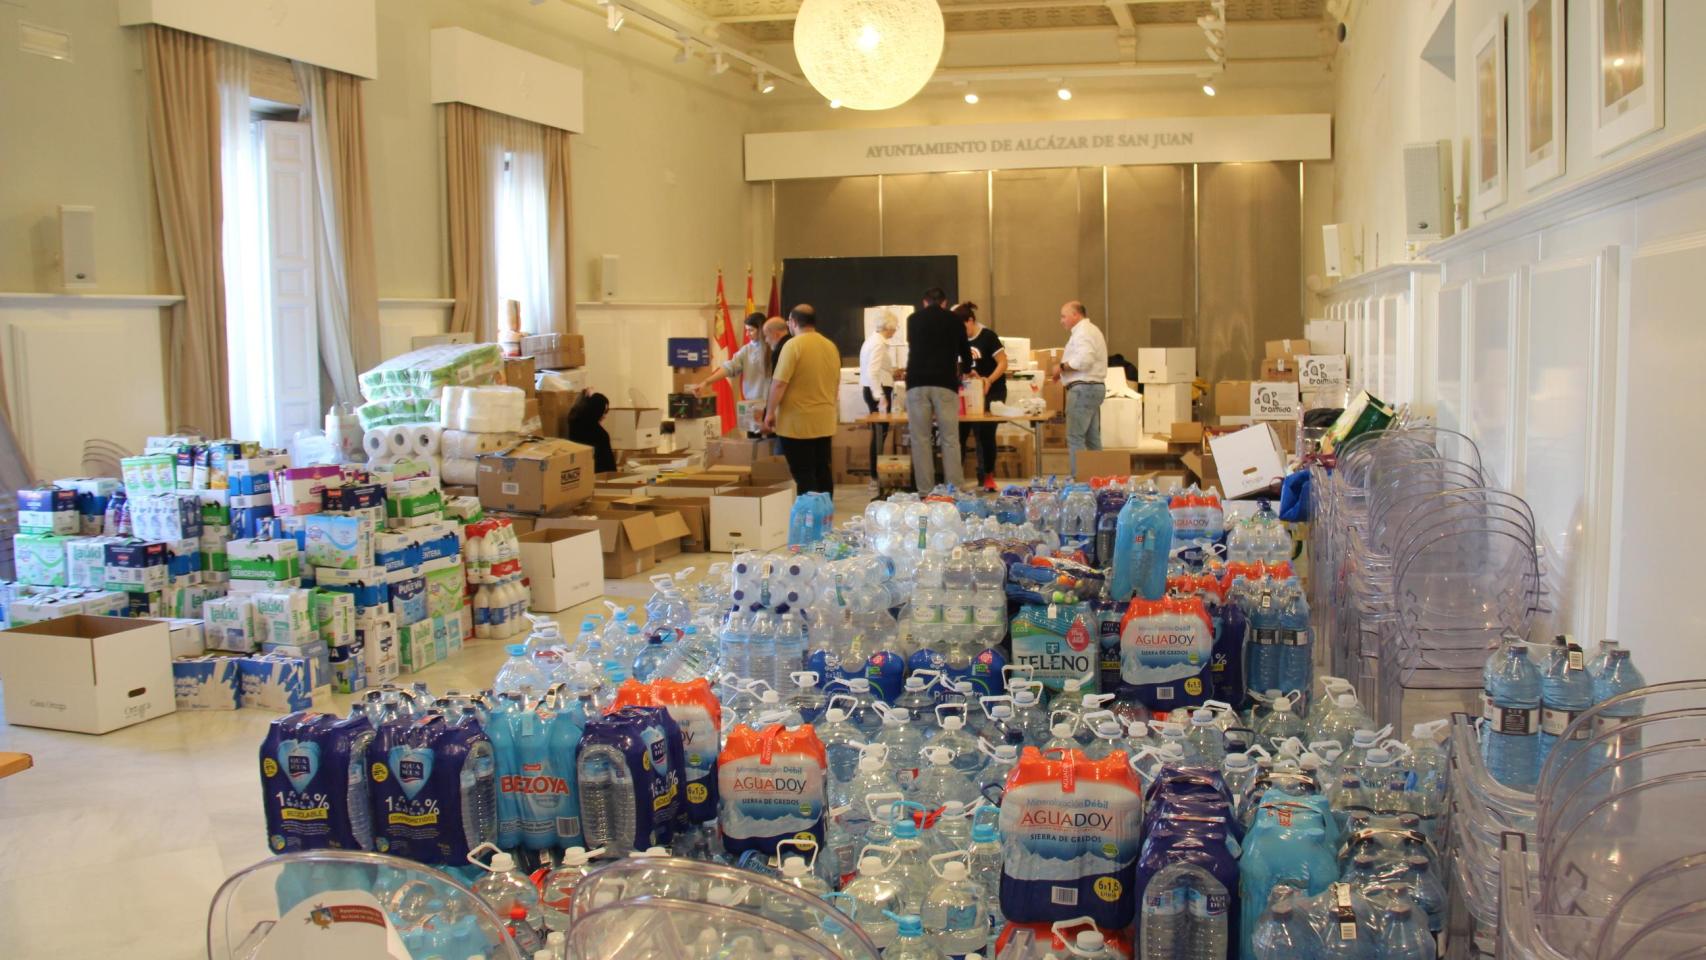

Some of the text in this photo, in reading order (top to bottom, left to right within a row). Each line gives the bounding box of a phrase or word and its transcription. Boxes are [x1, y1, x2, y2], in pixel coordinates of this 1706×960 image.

[866, 132, 1193, 158] AYUNTAMIENTO DE ALCÁZAR DE SAN JUAN
[1135, 634, 1195, 646] AGUADOY
[1018, 655, 1089, 672] TELENO
[499, 774, 570, 795] BEZOYA
[733, 776, 807, 794] AGUADOY
[1021, 810, 1113, 831] AGUADOY
[1030, 833, 1056, 841] SIERRA
[1070, 835, 1102, 843] GREDOS
